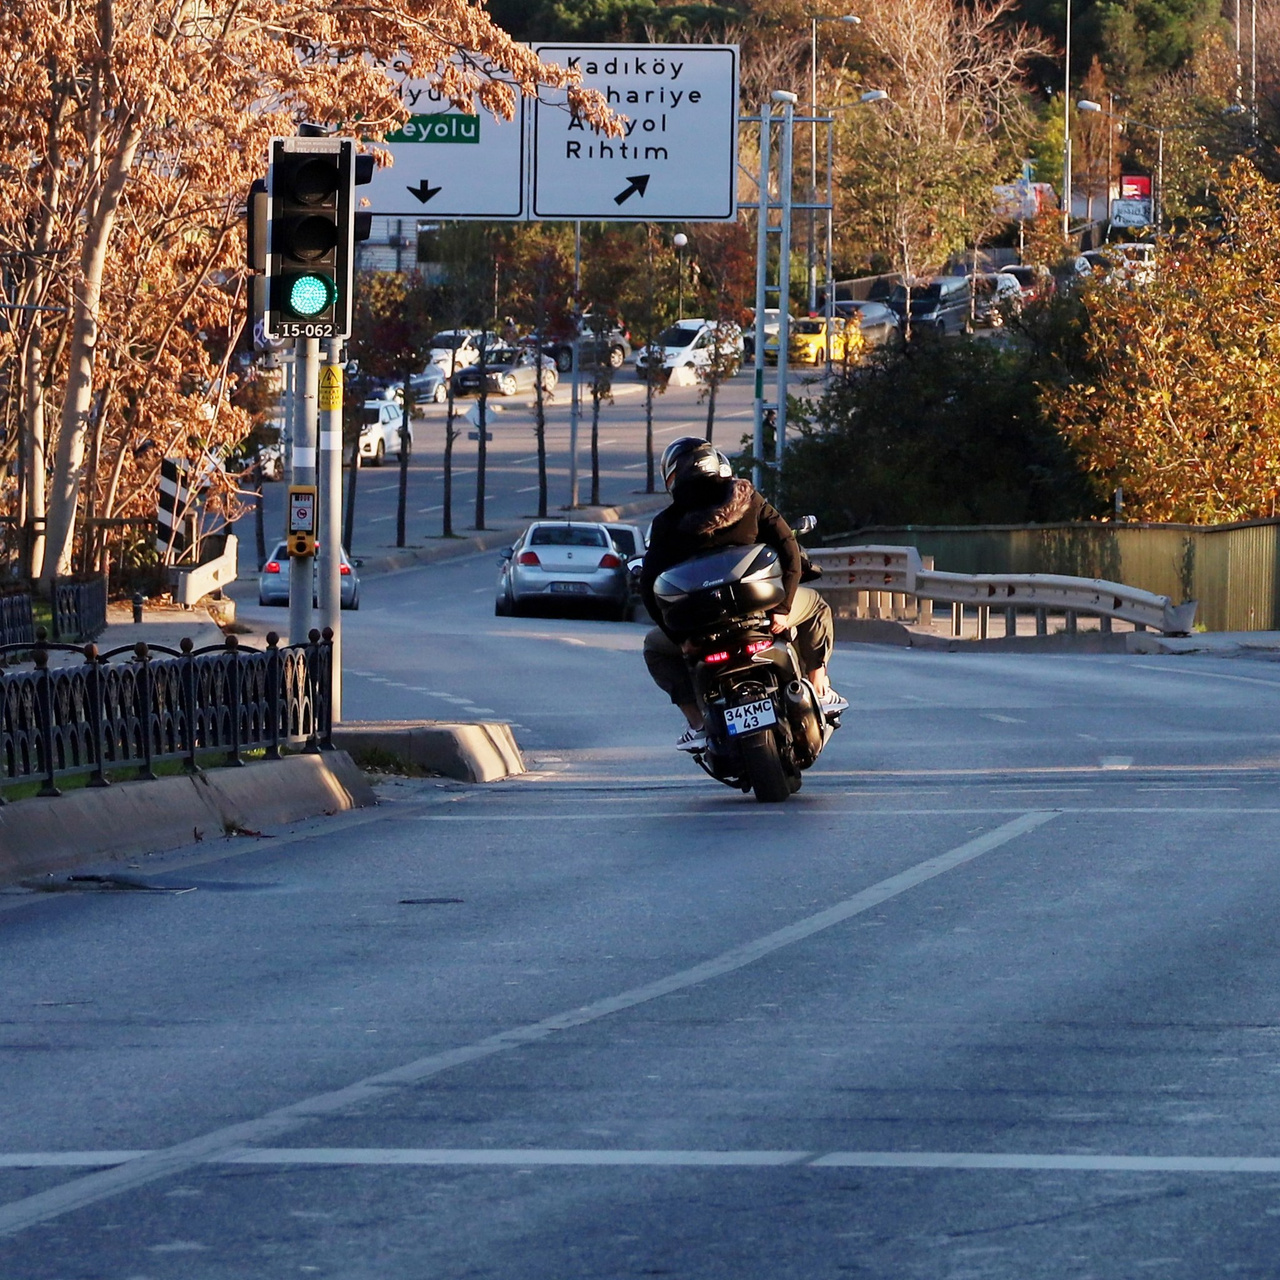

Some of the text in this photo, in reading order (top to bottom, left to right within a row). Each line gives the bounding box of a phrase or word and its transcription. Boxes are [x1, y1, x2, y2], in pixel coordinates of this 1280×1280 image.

[567, 56, 684, 80] Kadıköy
[567, 85, 702, 109] hariye
[565, 140, 669, 160] Rıhtım
[282, 323, 333, 338] 15-062
[726, 701, 771, 721] 34 KMC
[743, 716, 759, 729] 43
